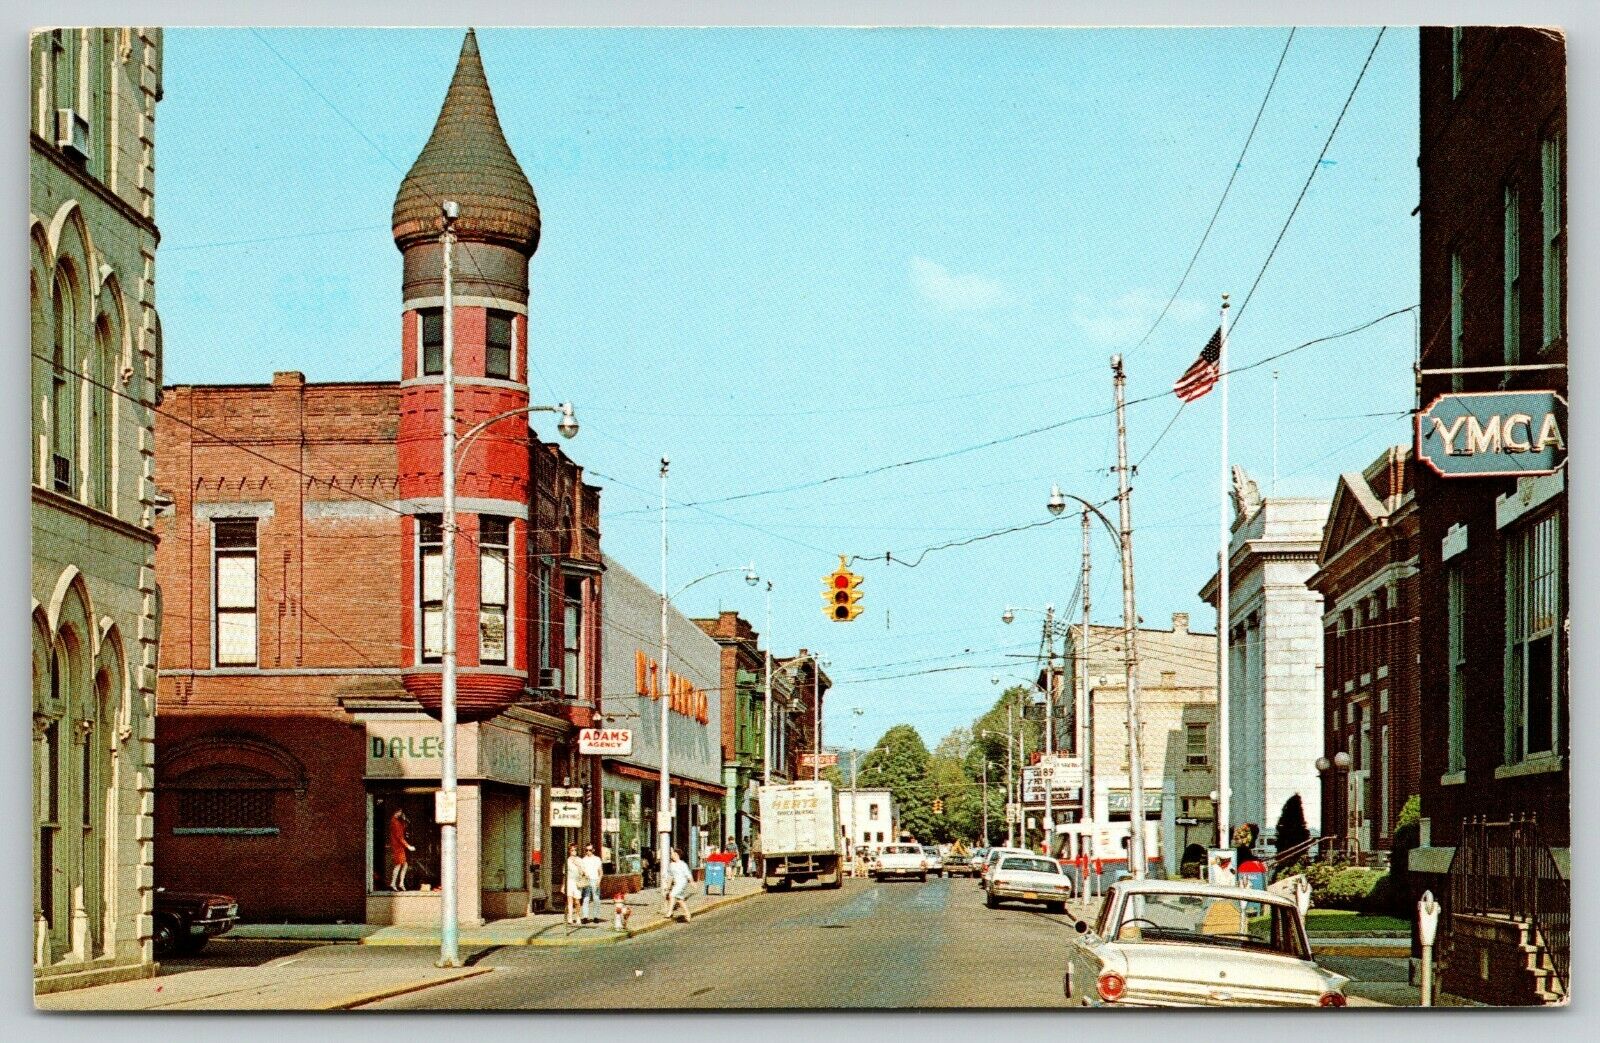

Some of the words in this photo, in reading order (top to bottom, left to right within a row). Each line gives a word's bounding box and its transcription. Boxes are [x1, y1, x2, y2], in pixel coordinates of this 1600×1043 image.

[1430, 411, 1567, 455] YMCA
[583, 731, 629, 741] ADAMS
[771, 797, 818, 809] HERTZ
